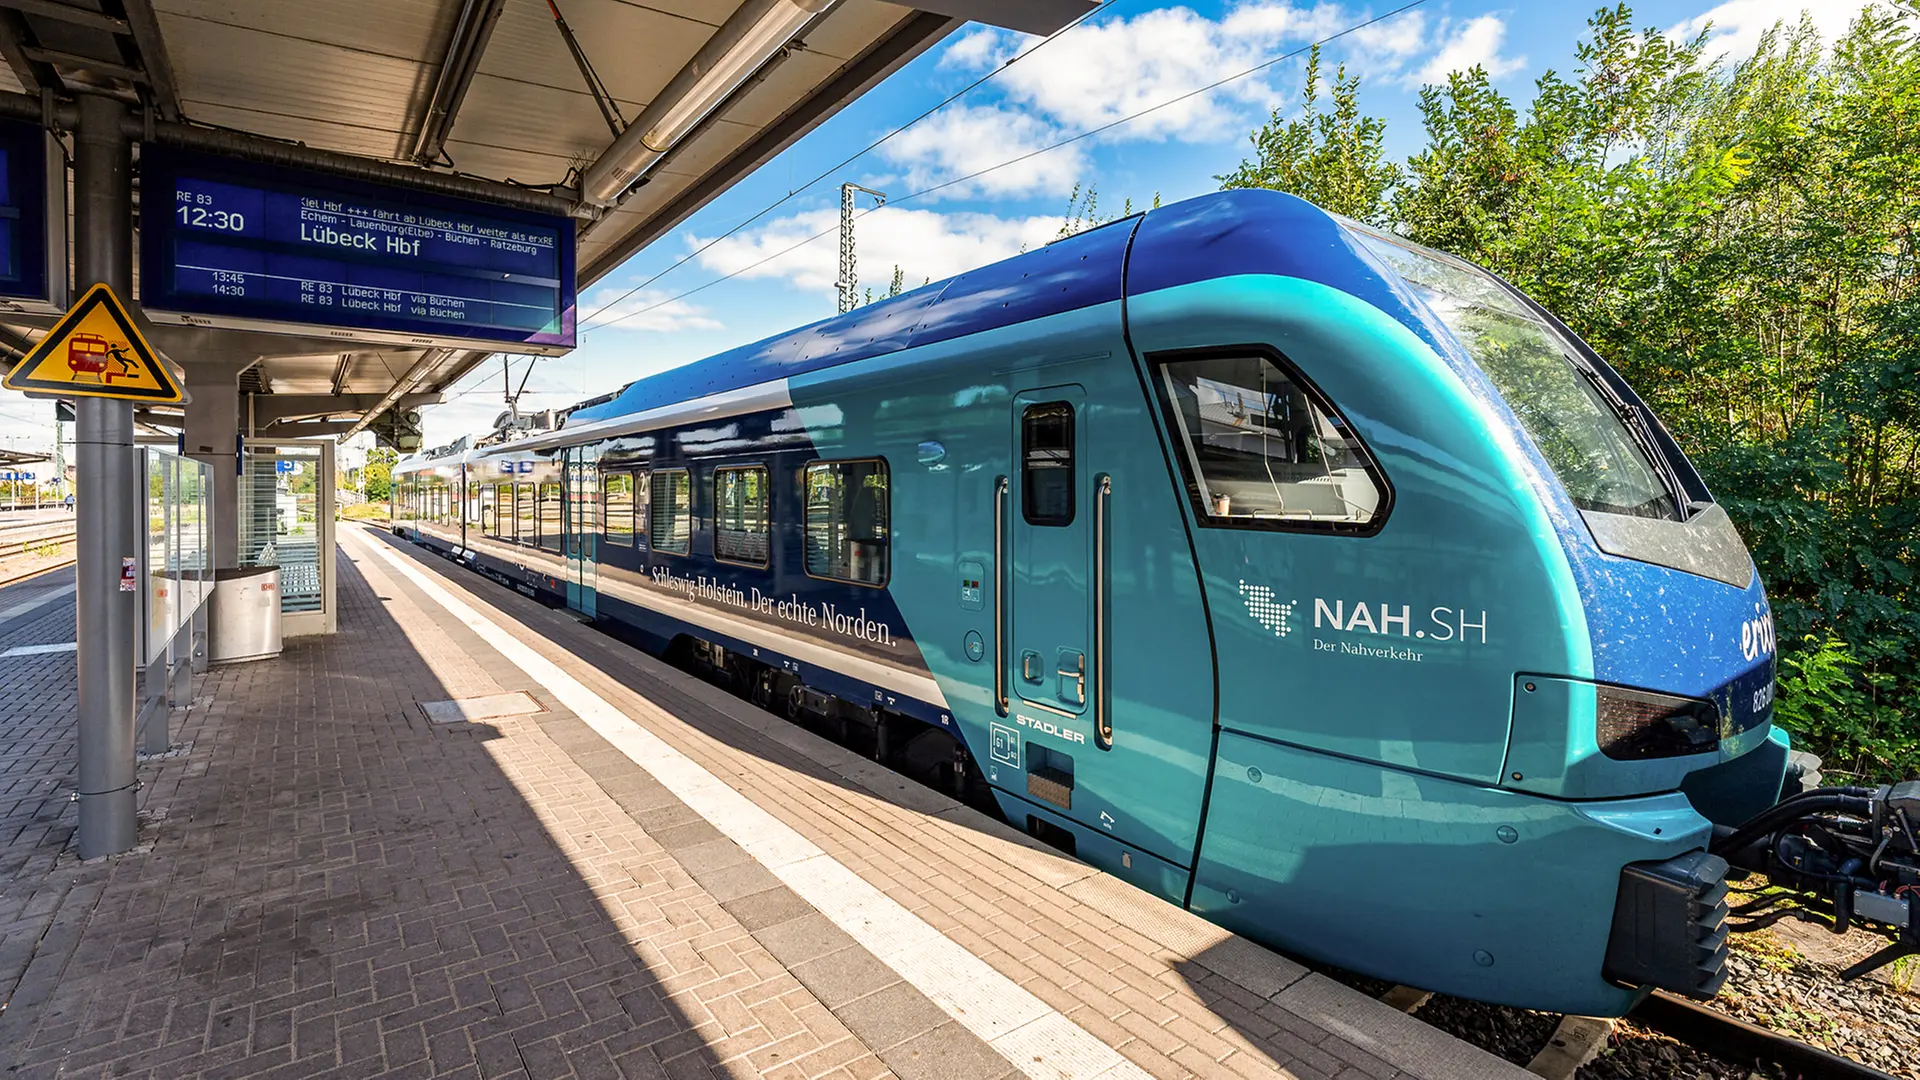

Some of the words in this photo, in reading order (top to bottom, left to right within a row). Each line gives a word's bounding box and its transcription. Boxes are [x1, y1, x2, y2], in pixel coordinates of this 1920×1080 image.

[177, 191, 192, 202] RE
[197, 194, 212, 205] 83
[178, 205, 244, 231] 12:30
[323, 201, 342, 212] Hbf
[373, 208, 400, 221] fährt
[403, 214, 416, 224] ab
[419, 216, 454, 230] Lübeck
[457, 222, 474, 232] Hbf
[476, 226, 508, 238] weiter
[511, 231, 525, 241] als
[301, 210, 337, 224] Echem
[350, 218, 434, 239] Lauenburg(Elbe)
[445, 231, 480, 246] Büchen
[490, 239, 537, 255] Ratzeburg
[301, 223, 378, 251] Lübeck
[387, 236, 420, 256] Hbf
[213, 271, 244, 284] 13:45
[213, 284, 244, 297] 14:30
[301, 281, 314, 291] RE
[319, 284, 332, 294] 83
[342, 286, 380, 299] Lübeck
[384, 291, 401, 301] Hbf
[411, 294, 426, 304] via
[430, 296, 465, 308] Büchen
[301, 294, 314, 304] RE
[319, 296, 332, 306] 83
[342, 298, 380, 311] Lübeck
[384, 303, 401, 313] Hbf
[411, 306, 426, 316] via
[430, 307, 465, 319] Büchen
[652, 566, 748, 608] Schleswig-Holstein.
[751, 587, 775, 615] Der
[777, 593, 817, 627] echte
[821, 602, 897, 647] Norden.
[1314, 598, 1486, 643] NAH.SH
[1313, 638, 1336, 652] Der
[1341, 642, 1423, 662] Nahverkehr
[1016, 714, 1085, 744] STADLER
